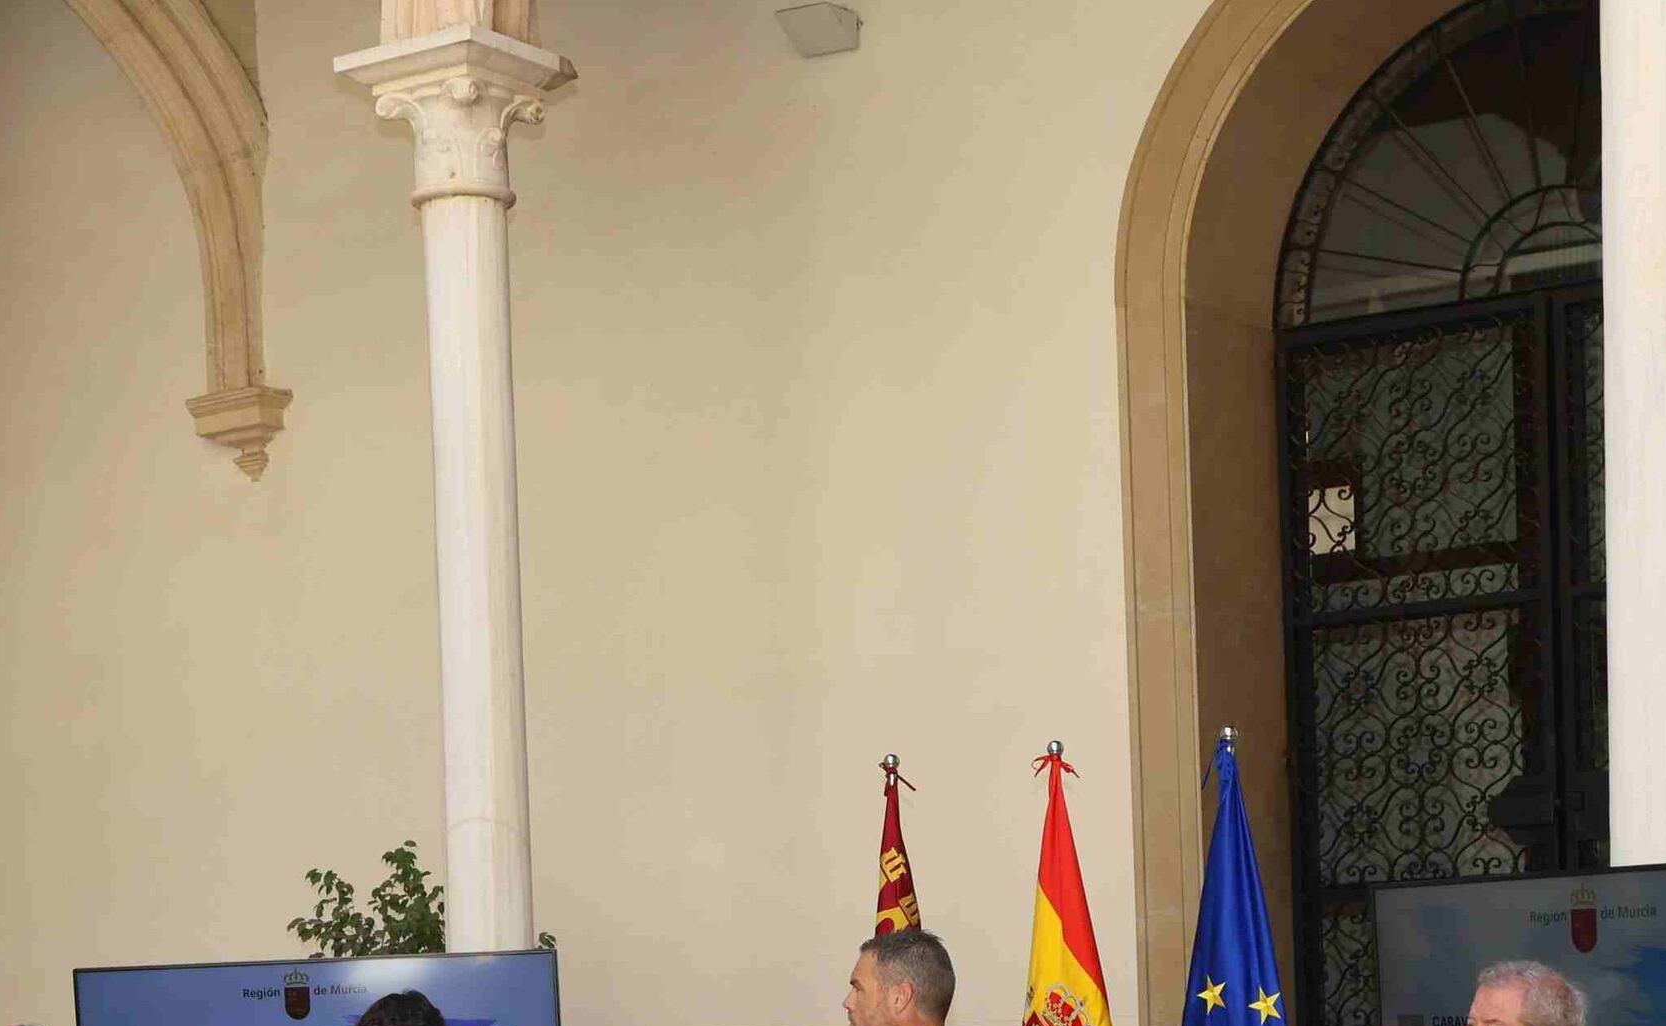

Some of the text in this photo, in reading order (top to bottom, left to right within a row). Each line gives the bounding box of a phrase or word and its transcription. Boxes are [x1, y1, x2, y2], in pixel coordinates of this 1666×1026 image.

[1529, 904, 1656, 926] Región de Murcia
[242, 984, 367, 1000] Región de Murcia
